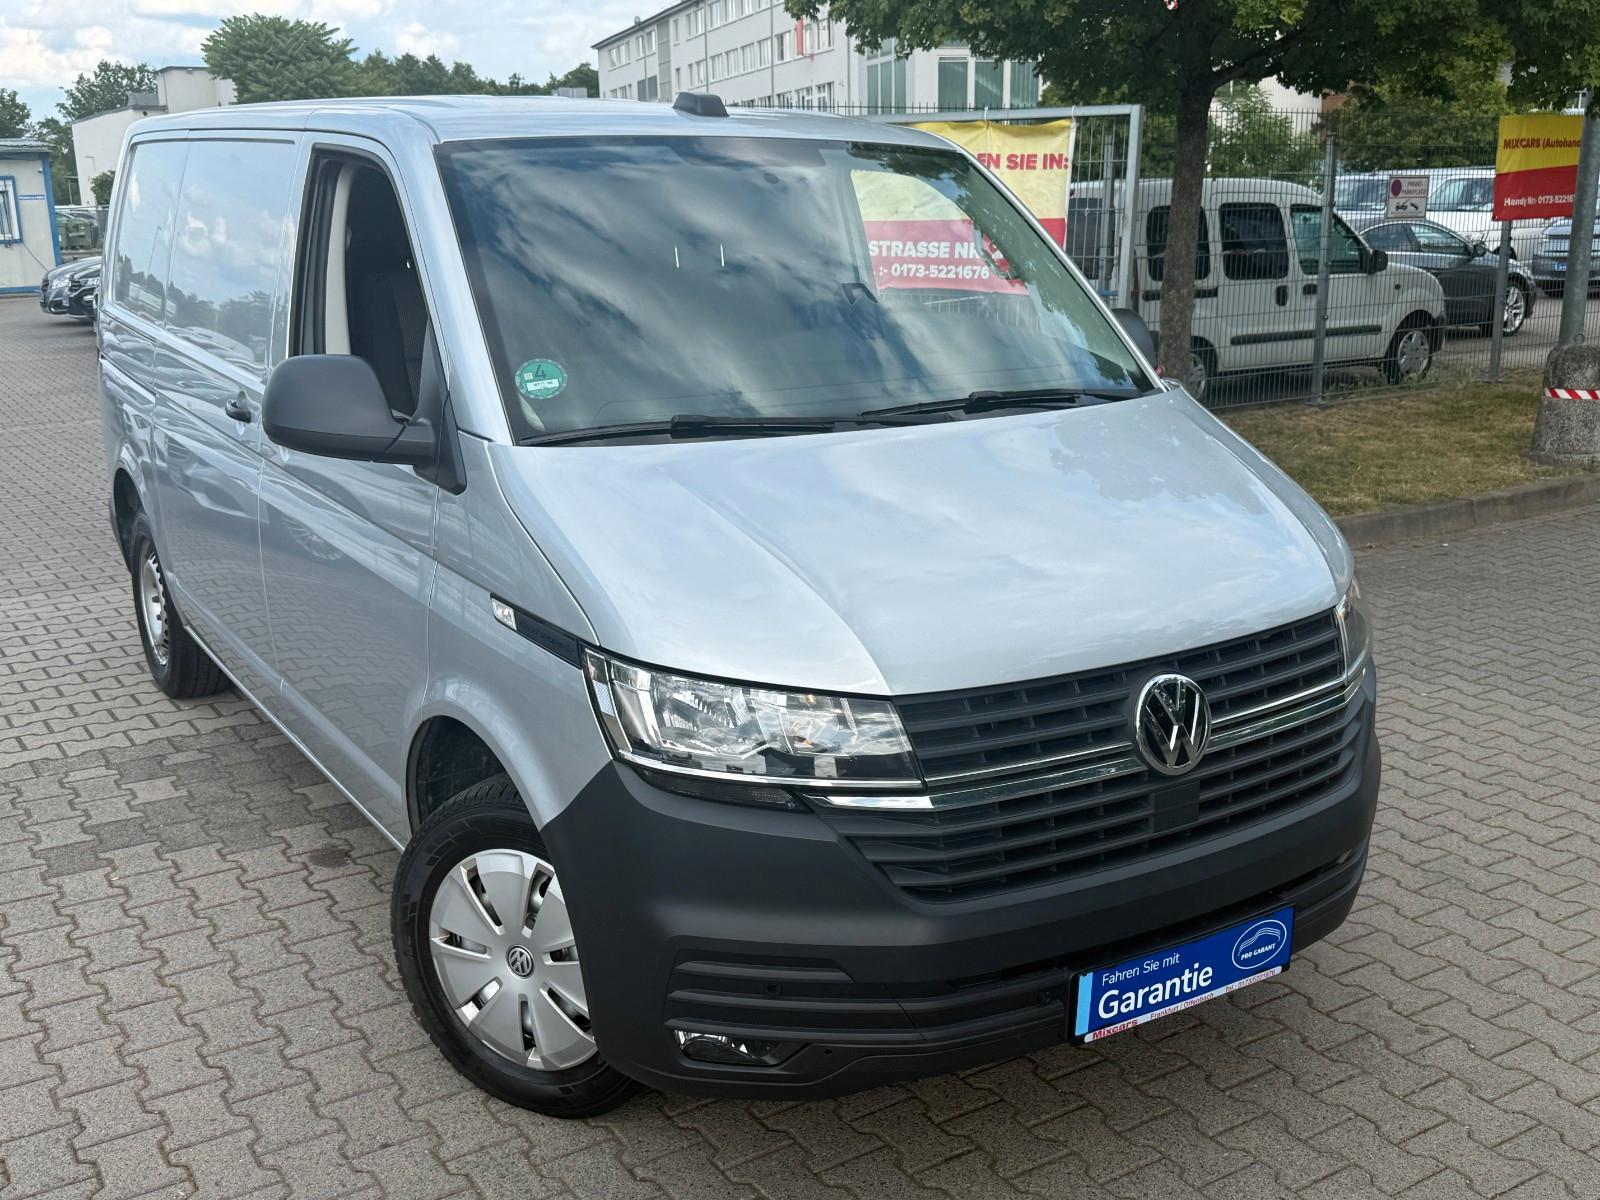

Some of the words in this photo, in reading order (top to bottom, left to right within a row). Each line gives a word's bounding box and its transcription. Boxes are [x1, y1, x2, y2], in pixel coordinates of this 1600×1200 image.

[1503, 139, 1541, 150] MIXCARS
[1006, 153, 1037, 170] SIE
[1042, 153, 1069, 170] IN:
[891, 263, 990, 280] 0173-5221676
[1240, 951, 1253, 961] PRO
[1253, 943, 1276, 956] GARANT
[1101, 965, 1140, 987] Fahren
[1143, 959, 1160, 974] Sie
[1162, 953, 1181, 969] mit
[1098, 962, 1213, 1019] Garantie
[1091, 1018, 1138, 1040] Mixcars
[1150, 1003, 1180, 1020] Frankfurt
[1183, 993, 1214, 1009] Offenbach
